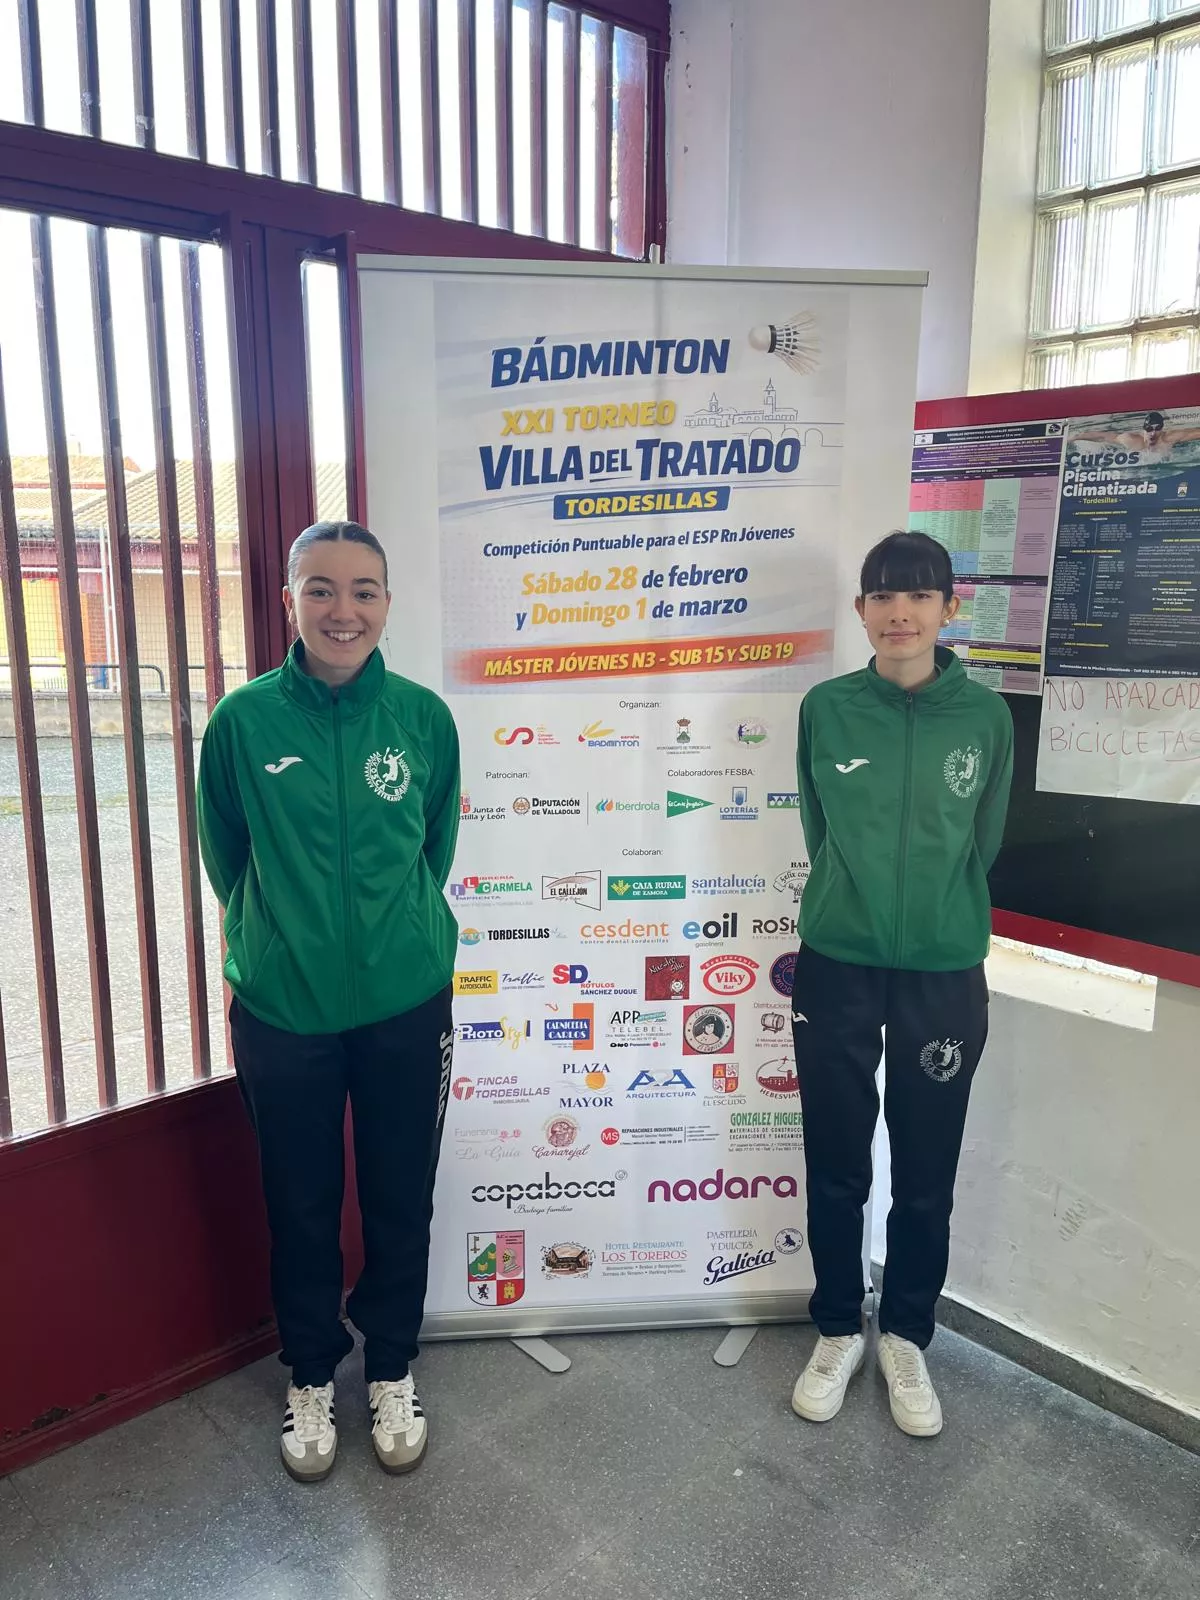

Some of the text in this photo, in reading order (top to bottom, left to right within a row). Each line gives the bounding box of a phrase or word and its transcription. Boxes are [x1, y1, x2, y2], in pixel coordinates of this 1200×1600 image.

[491, 336, 730, 388] BÁDMINTON
[501, 400, 677, 436] XXI TORNEO
[479, 437, 801, 490] VILLA DEL TRATADO
[1066, 452, 1140, 468] Cursos
[1064, 468, 1121, 483] Piscina
[1063, 481, 1157, 497] Climatizada
[565, 490, 718, 518] TORDESILLAS
[482, 525, 796, 559] Competición Puntuable para el ESP Rn Jóvenes
[521, 562, 749, 596] Sábado 28 de febrero
[515, 597, 749, 631] y Domingo 1 de marzo
[484, 655, 555, 677] MÁSTER
[556, 652, 629, 673] JÓVENES
[631, 652, 657, 669] N3
[668, 649, 702, 667] SUB
[704, 646, 724, 664] 15
[726, 648, 737, 663] Y
[738, 645, 773, 661] SUB
[774, 642, 795, 659] 19
[1049, 680, 1084, 712] NO
[619, 700, 661, 710] Organizan:
[588, 740, 640, 748] BADMINTON
[485, 771, 530, 780] Patrocinan:
[667, 768, 756, 777] Colaboradores FESBA:
[532, 797, 580, 808] DIPUTACIÓN
[615, 801, 660, 812] Iberdrola
[543, 807, 581, 816] VALLADOLID
[720, 805, 759, 814] LOTERÍAS
[459, 813, 479, 821] stilla
[487, 812, 506, 820] León
[633, 881, 684, 890] CAJA RURAL
[692, 874, 766, 889] santalucía
[476, 883, 533, 895] CARMELA
[580, 919, 669, 938] cesdent
[682, 912, 738, 940] eoil
[488, 928, 550, 941] TORDESILLAS
[715, 972, 745, 985] Viky
[610, 1010, 640, 1024] APP
[549, 1032, 587, 1041] CARLOS
[562, 1063, 611, 1074] PLAZA
[477, 1076, 518, 1085] FINCAS
[475, 1087, 550, 1099] TORDESILLAS
[560, 1096, 613, 1108] MAYOR
[731, 1113, 771, 1126] GONZALEZ
[602, 1132, 619, 1141] MS
[472, 1172, 615, 1208] copaboca
[648, 1169, 797, 1202] nadara
[633, 1241, 684, 1249] RESTAURANTE
[719, 1241, 753, 1250] DULCES
[602, 1250, 687, 1262] LOS TOREROS
